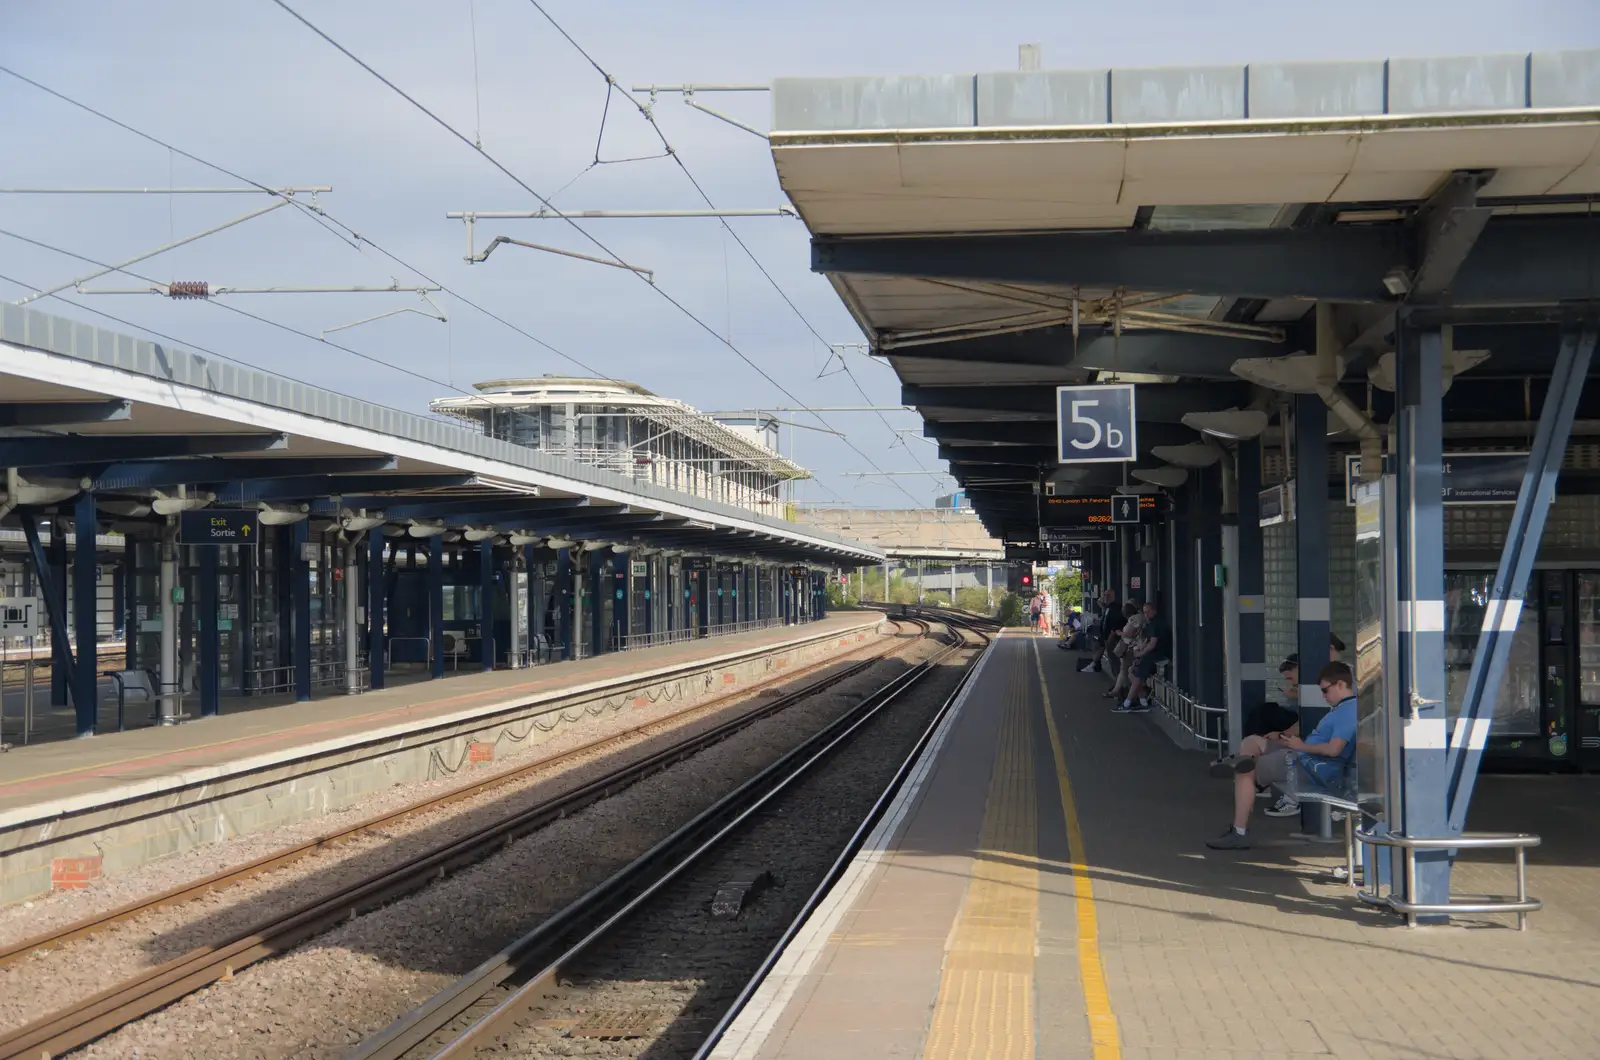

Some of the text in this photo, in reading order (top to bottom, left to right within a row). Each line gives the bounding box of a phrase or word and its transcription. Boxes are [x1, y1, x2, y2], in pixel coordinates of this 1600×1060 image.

[1070, 400, 1123, 449] 5b
[210, 517, 227, 526] Exit
[210, 528, 236, 537] Sortie
